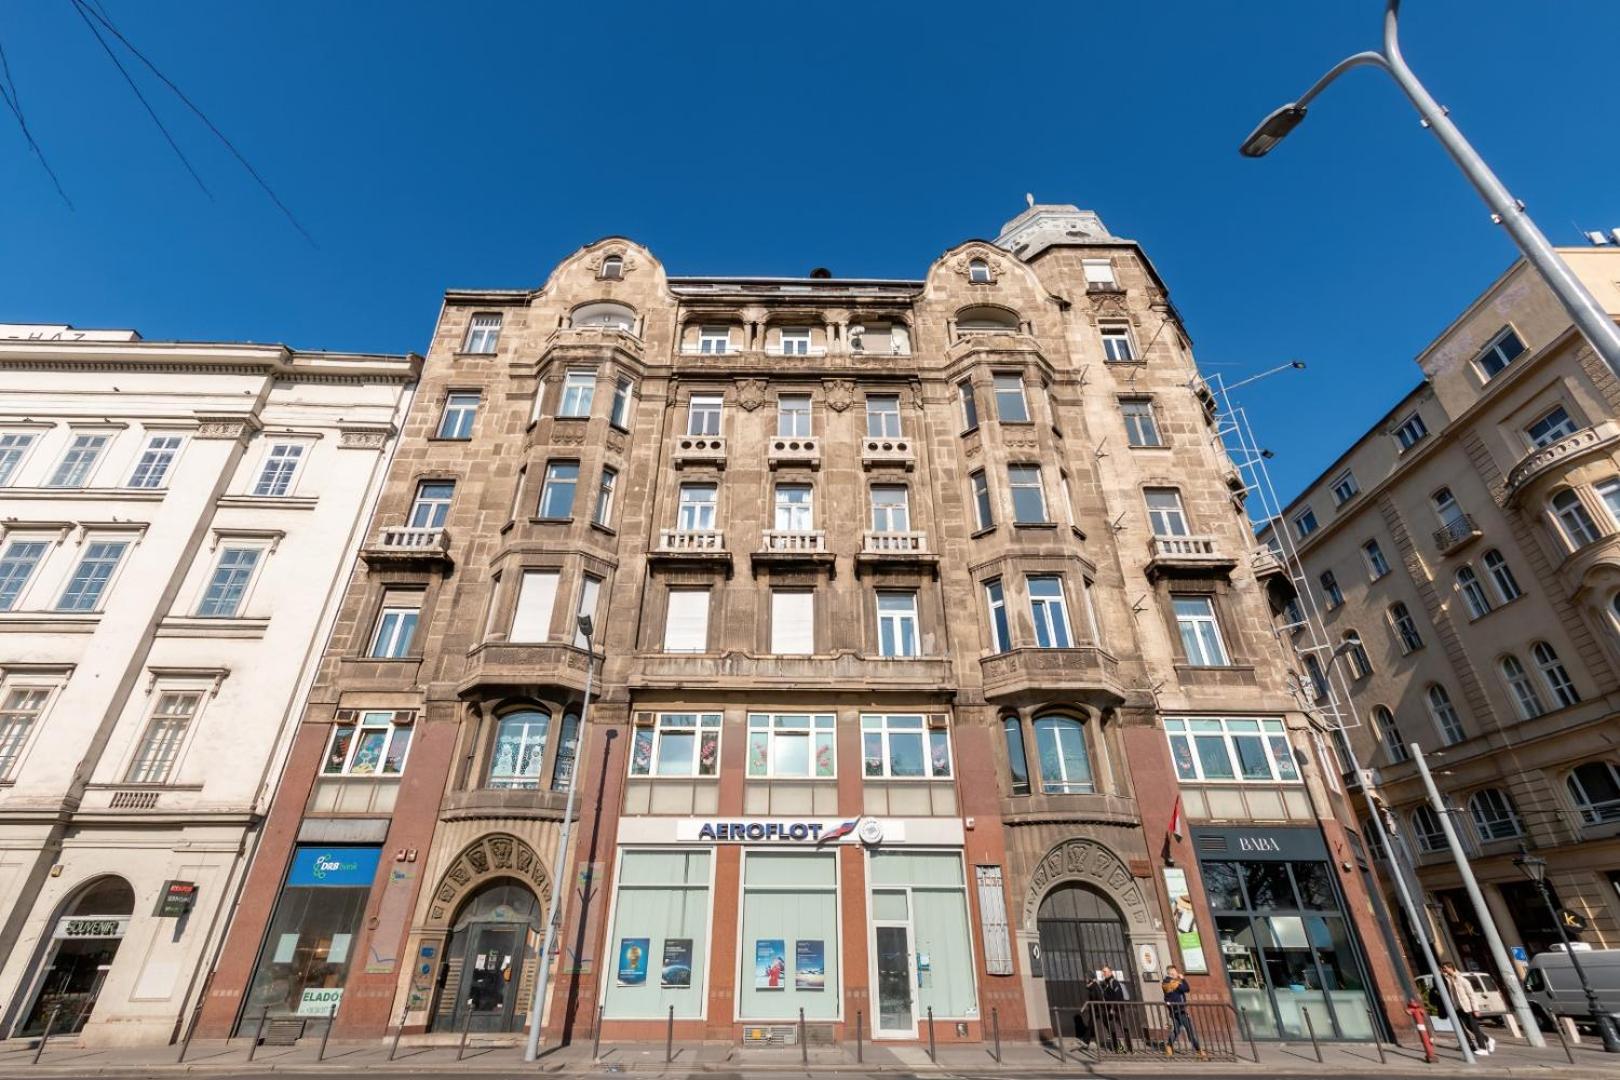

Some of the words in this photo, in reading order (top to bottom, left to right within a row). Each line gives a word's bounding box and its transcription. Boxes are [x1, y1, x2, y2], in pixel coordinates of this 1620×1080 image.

[699, 823, 823, 840] AEROFLOT
[1239, 837, 1280, 851] BABA
[66, 920, 117, 935] SOUVENIR
